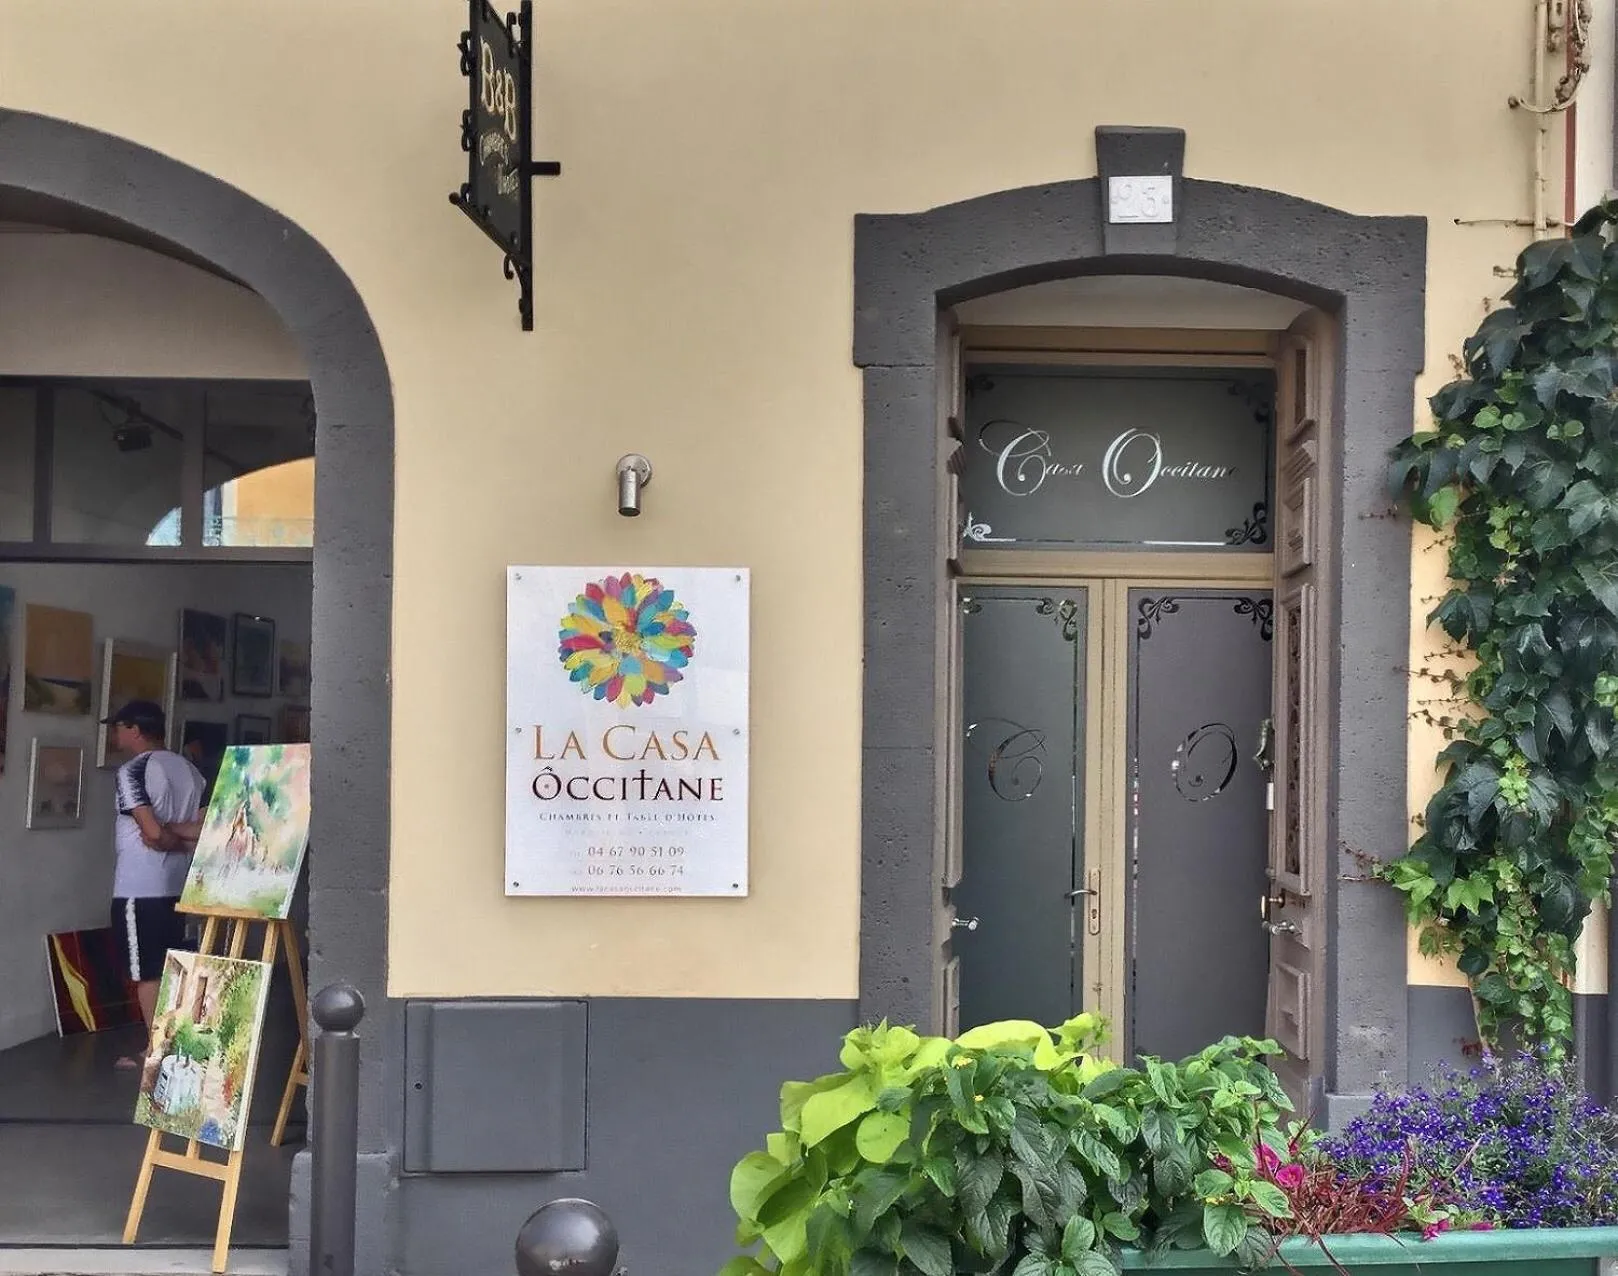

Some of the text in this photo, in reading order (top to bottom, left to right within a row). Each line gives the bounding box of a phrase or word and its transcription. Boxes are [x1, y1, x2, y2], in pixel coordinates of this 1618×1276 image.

[588, 846, 604, 857] 04
[609, 846, 624, 857] 67
[629, 846, 645, 857] 90
[651, 846, 664, 857] 51
[668, 846, 684, 857] 09
[588, 865, 604, 876] 06
[609, 865, 624, 876] 76
[629, 865, 644, 876] 56
[648, 865, 665, 876] 66
[670, 865, 684, 876] 74
